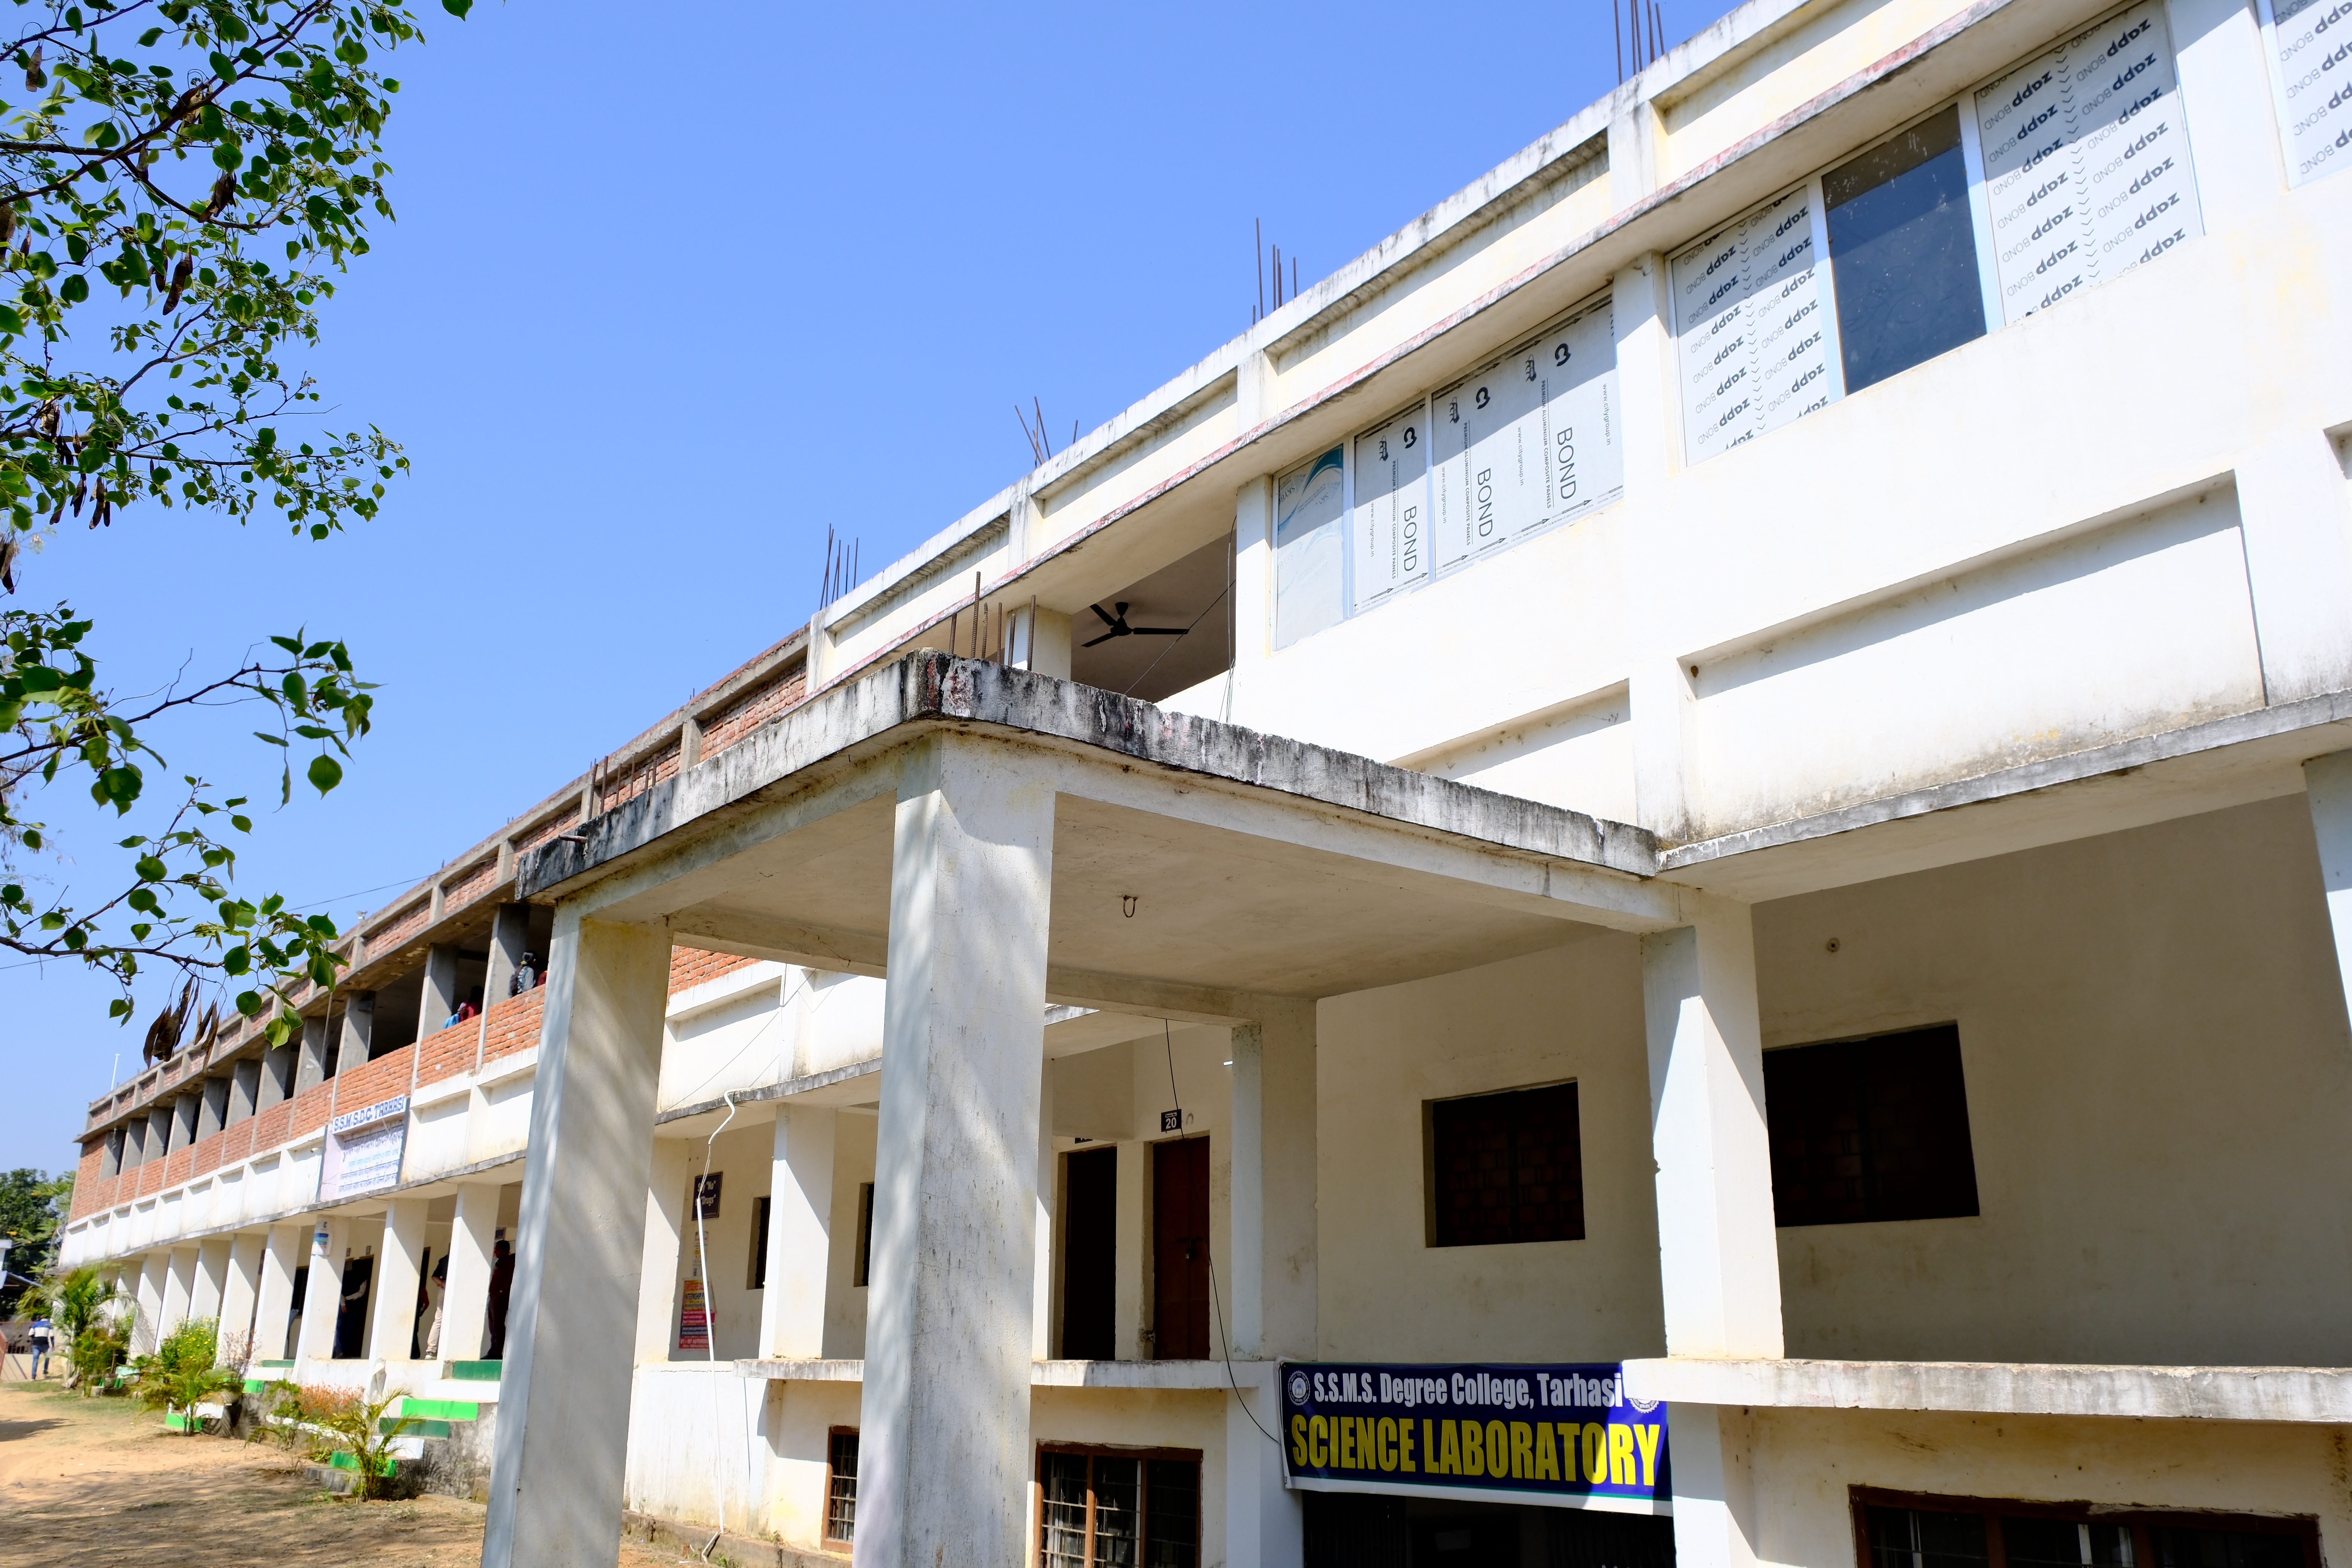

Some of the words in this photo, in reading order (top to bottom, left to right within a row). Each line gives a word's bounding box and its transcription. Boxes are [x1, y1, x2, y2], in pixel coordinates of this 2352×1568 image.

[2107, 18, 2151, 58] zapp
[2280, 31, 2314, 61] BOND
[2076, 54, 2106, 81] BOND
[2113, 52, 2157, 90] zapp
[2012, 70, 2053, 107] zapp
[2287, 68, 2321, 98] BOND
[2082, 88, 2112, 115] BOND
[2118, 87, 2163, 126] zapp
[1984, 104, 2012, 130] BOND
[2017, 104, 2058, 141] zapp
[2294, 106, 2328, 135] BOND
[1989, 137, 2017, 162] BOND
[2088, 122, 2118, 149] BOND
[2124, 122, 2168, 160] zapp
[2022, 137, 2064, 173] zapp
[2093, 156, 2123, 183] BOND
[2300, 145, 2334, 174] BOND
[1994, 170, 2021, 195] BOND
[2027, 172, 2068, 208] zapp
[2129, 156, 2174, 194] zapp
[1998, 204, 2026, 228] BOND
[2098, 191, 2128, 217] BOND
[2135, 191, 2180, 229] zapp
[1776, 206, 1808, 237] zapp
[2032, 206, 2073, 241] zapp
[1753, 234, 1775, 257] BOND
[1778, 236, 1812, 268] zapp
[2003, 237, 2030, 262] BOND
[2104, 227, 2133, 252] BOND
[2140, 228, 2186, 264] zapp
[1706, 245, 1736, 275] zapp
[2036, 240, 2078, 274] zapp
[1686, 273, 1706, 294] BOND
[1709, 275, 1738, 305] zapp
[1756, 265, 1778, 287] BOND
[1782, 266, 1815, 298] zapp
[2007, 271, 2035, 296] BOND
[1759, 295, 1781, 317] BOND
[2041, 274, 2083, 309] zapp
[1689, 302, 1709, 323] BOND
[1711, 305, 1741, 335] zapp
[1784, 298, 1819, 330] zapp
[1691, 332, 1711, 353] BOND
[1714, 335, 1744, 365] zapp
[1762, 326, 1784, 348] BOND
[1788, 330, 1822, 361] zapp
[1694, 362, 1713, 383] BOND
[1717, 366, 1747, 396] zapp
[1765, 358, 1787, 379] BOND
[1791, 362, 1825, 394] zapp
[1603, 383, 1611, 446] www.citygroup.in
[1696, 392, 1716, 413] BOND
[1720, 398, 1750, 427] zapp
[1769, 389, 1791, 411] BOND
[1698, 423, 1719, 444] BOND
[1557, 427, 1576, 499] BOND
[1478, 467, 1493, 537] BOND
[1404, 505, 1417, 571] BOND
[1165, 1117, 1177, 1129] 20
[1314, 1372, 1377, 1403] S.S.M.S.
[1380, 1373, 1447, 1407] Degree
[1452, 1372, 1534, 1410] College,
[1537, 1372, 1623, 1407] Tarhasi
[1291, 1414, 1416, 1472] SCIENCE
[1423, 1419, 1660, 1486] LABORATORY
